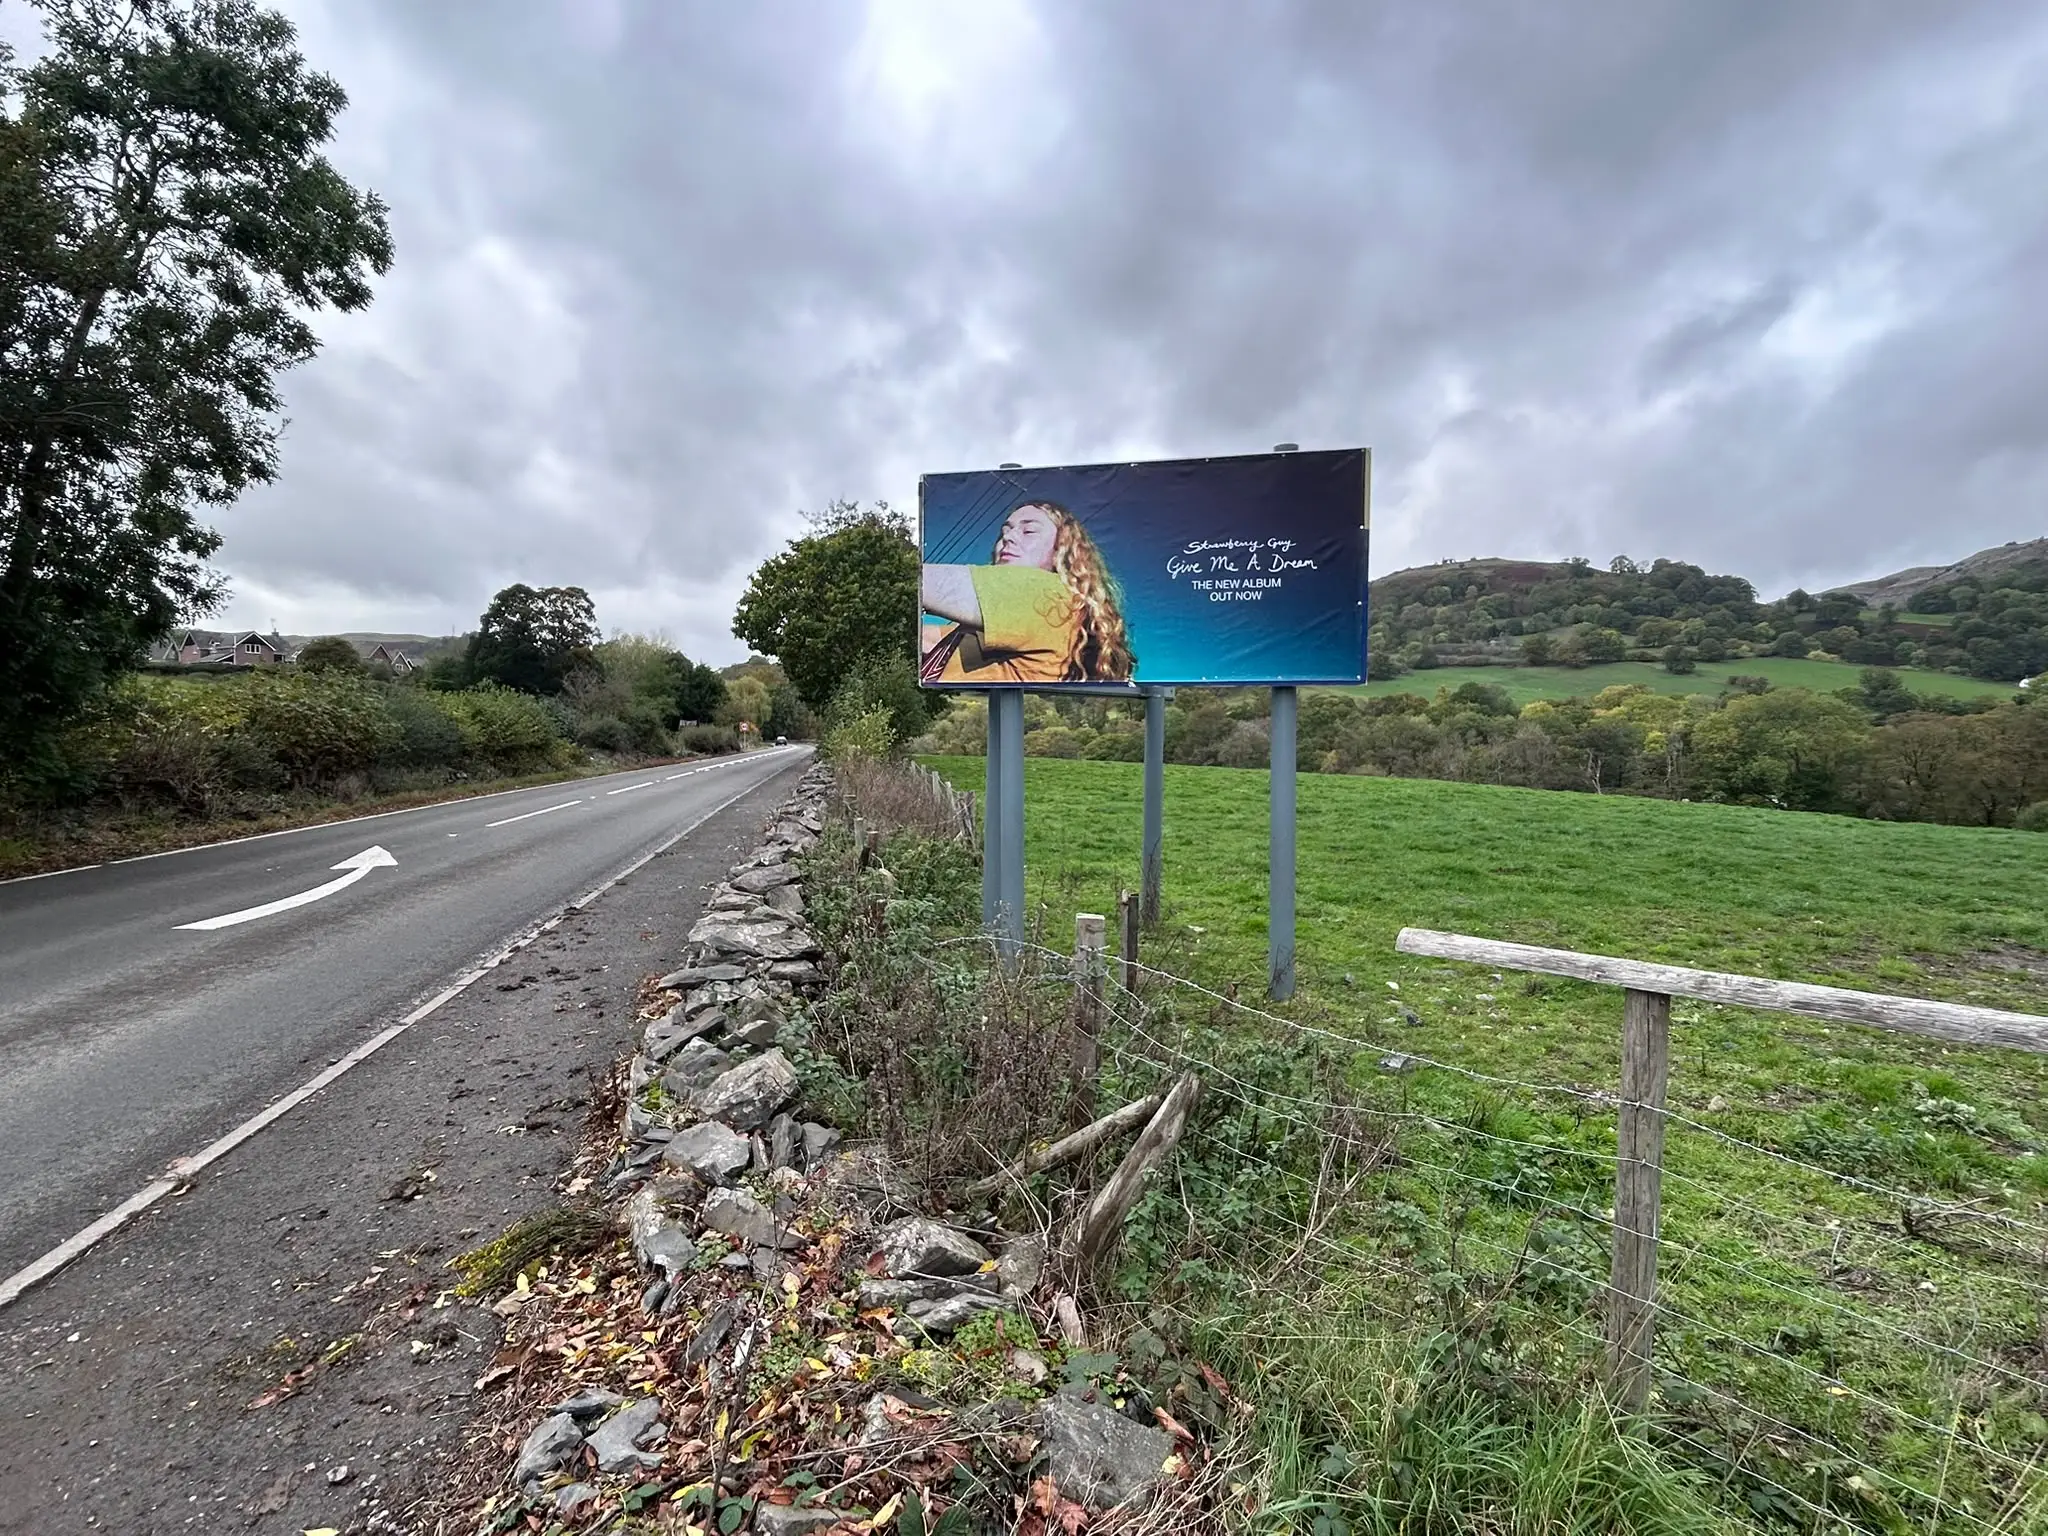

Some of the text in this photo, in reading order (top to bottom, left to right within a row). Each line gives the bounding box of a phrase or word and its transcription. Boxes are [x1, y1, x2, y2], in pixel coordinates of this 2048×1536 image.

[1183, 537, 1297, 554] Strawberry Guy
[1166, 553, 1318, 579] Give Me A Dream
[1191, 578, 1281, 590] THE NEW ALBUM
[1209, 590, 1262, 602] OUT NOW
